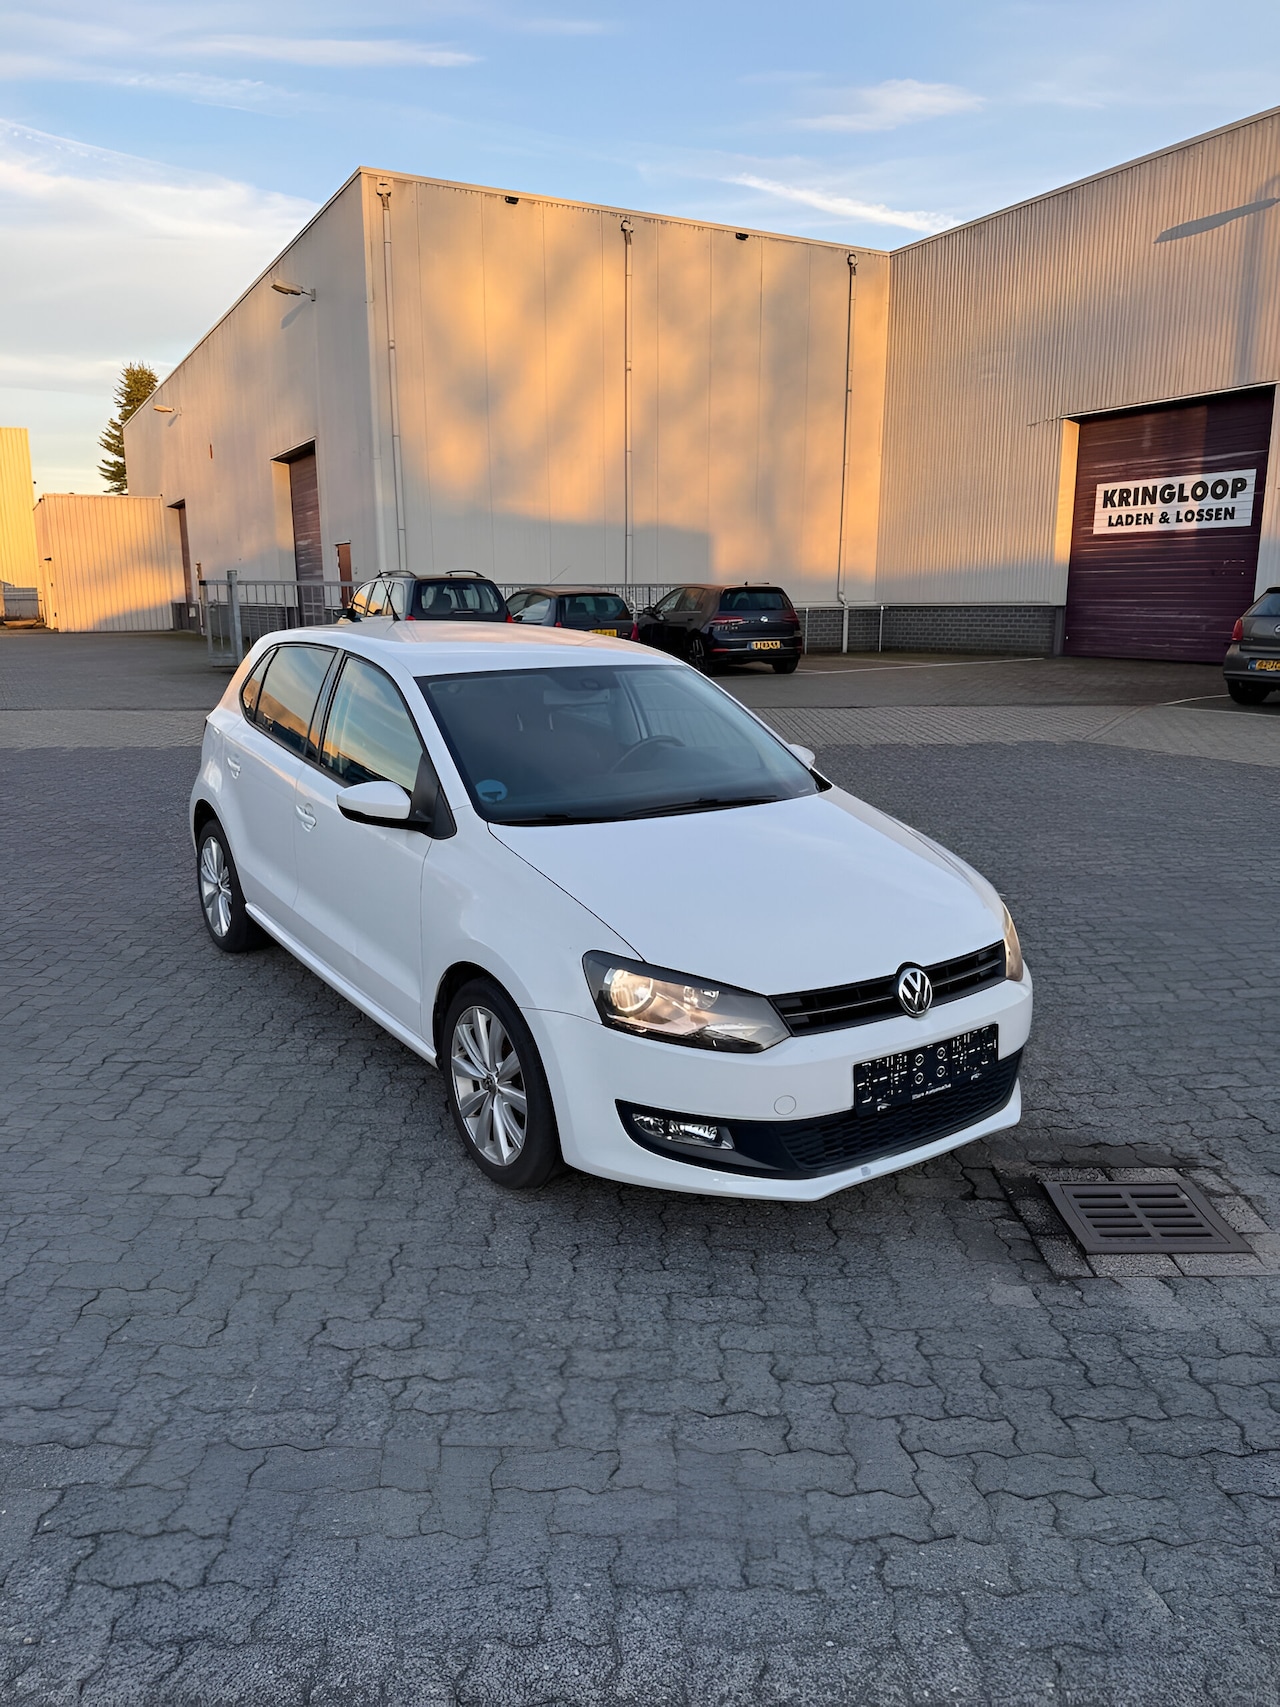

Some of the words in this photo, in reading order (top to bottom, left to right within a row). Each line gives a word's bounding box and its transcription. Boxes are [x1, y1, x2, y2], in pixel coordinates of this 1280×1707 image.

[1102, 477, 1247, 508] KRINGLOOP
[1108, 512, 1154, 527] LADEN
[1158, 511, 1171, 524] &
[1175, 507, 1236, 523] LOSSEN
[900, 969, 932, 1013] VW
